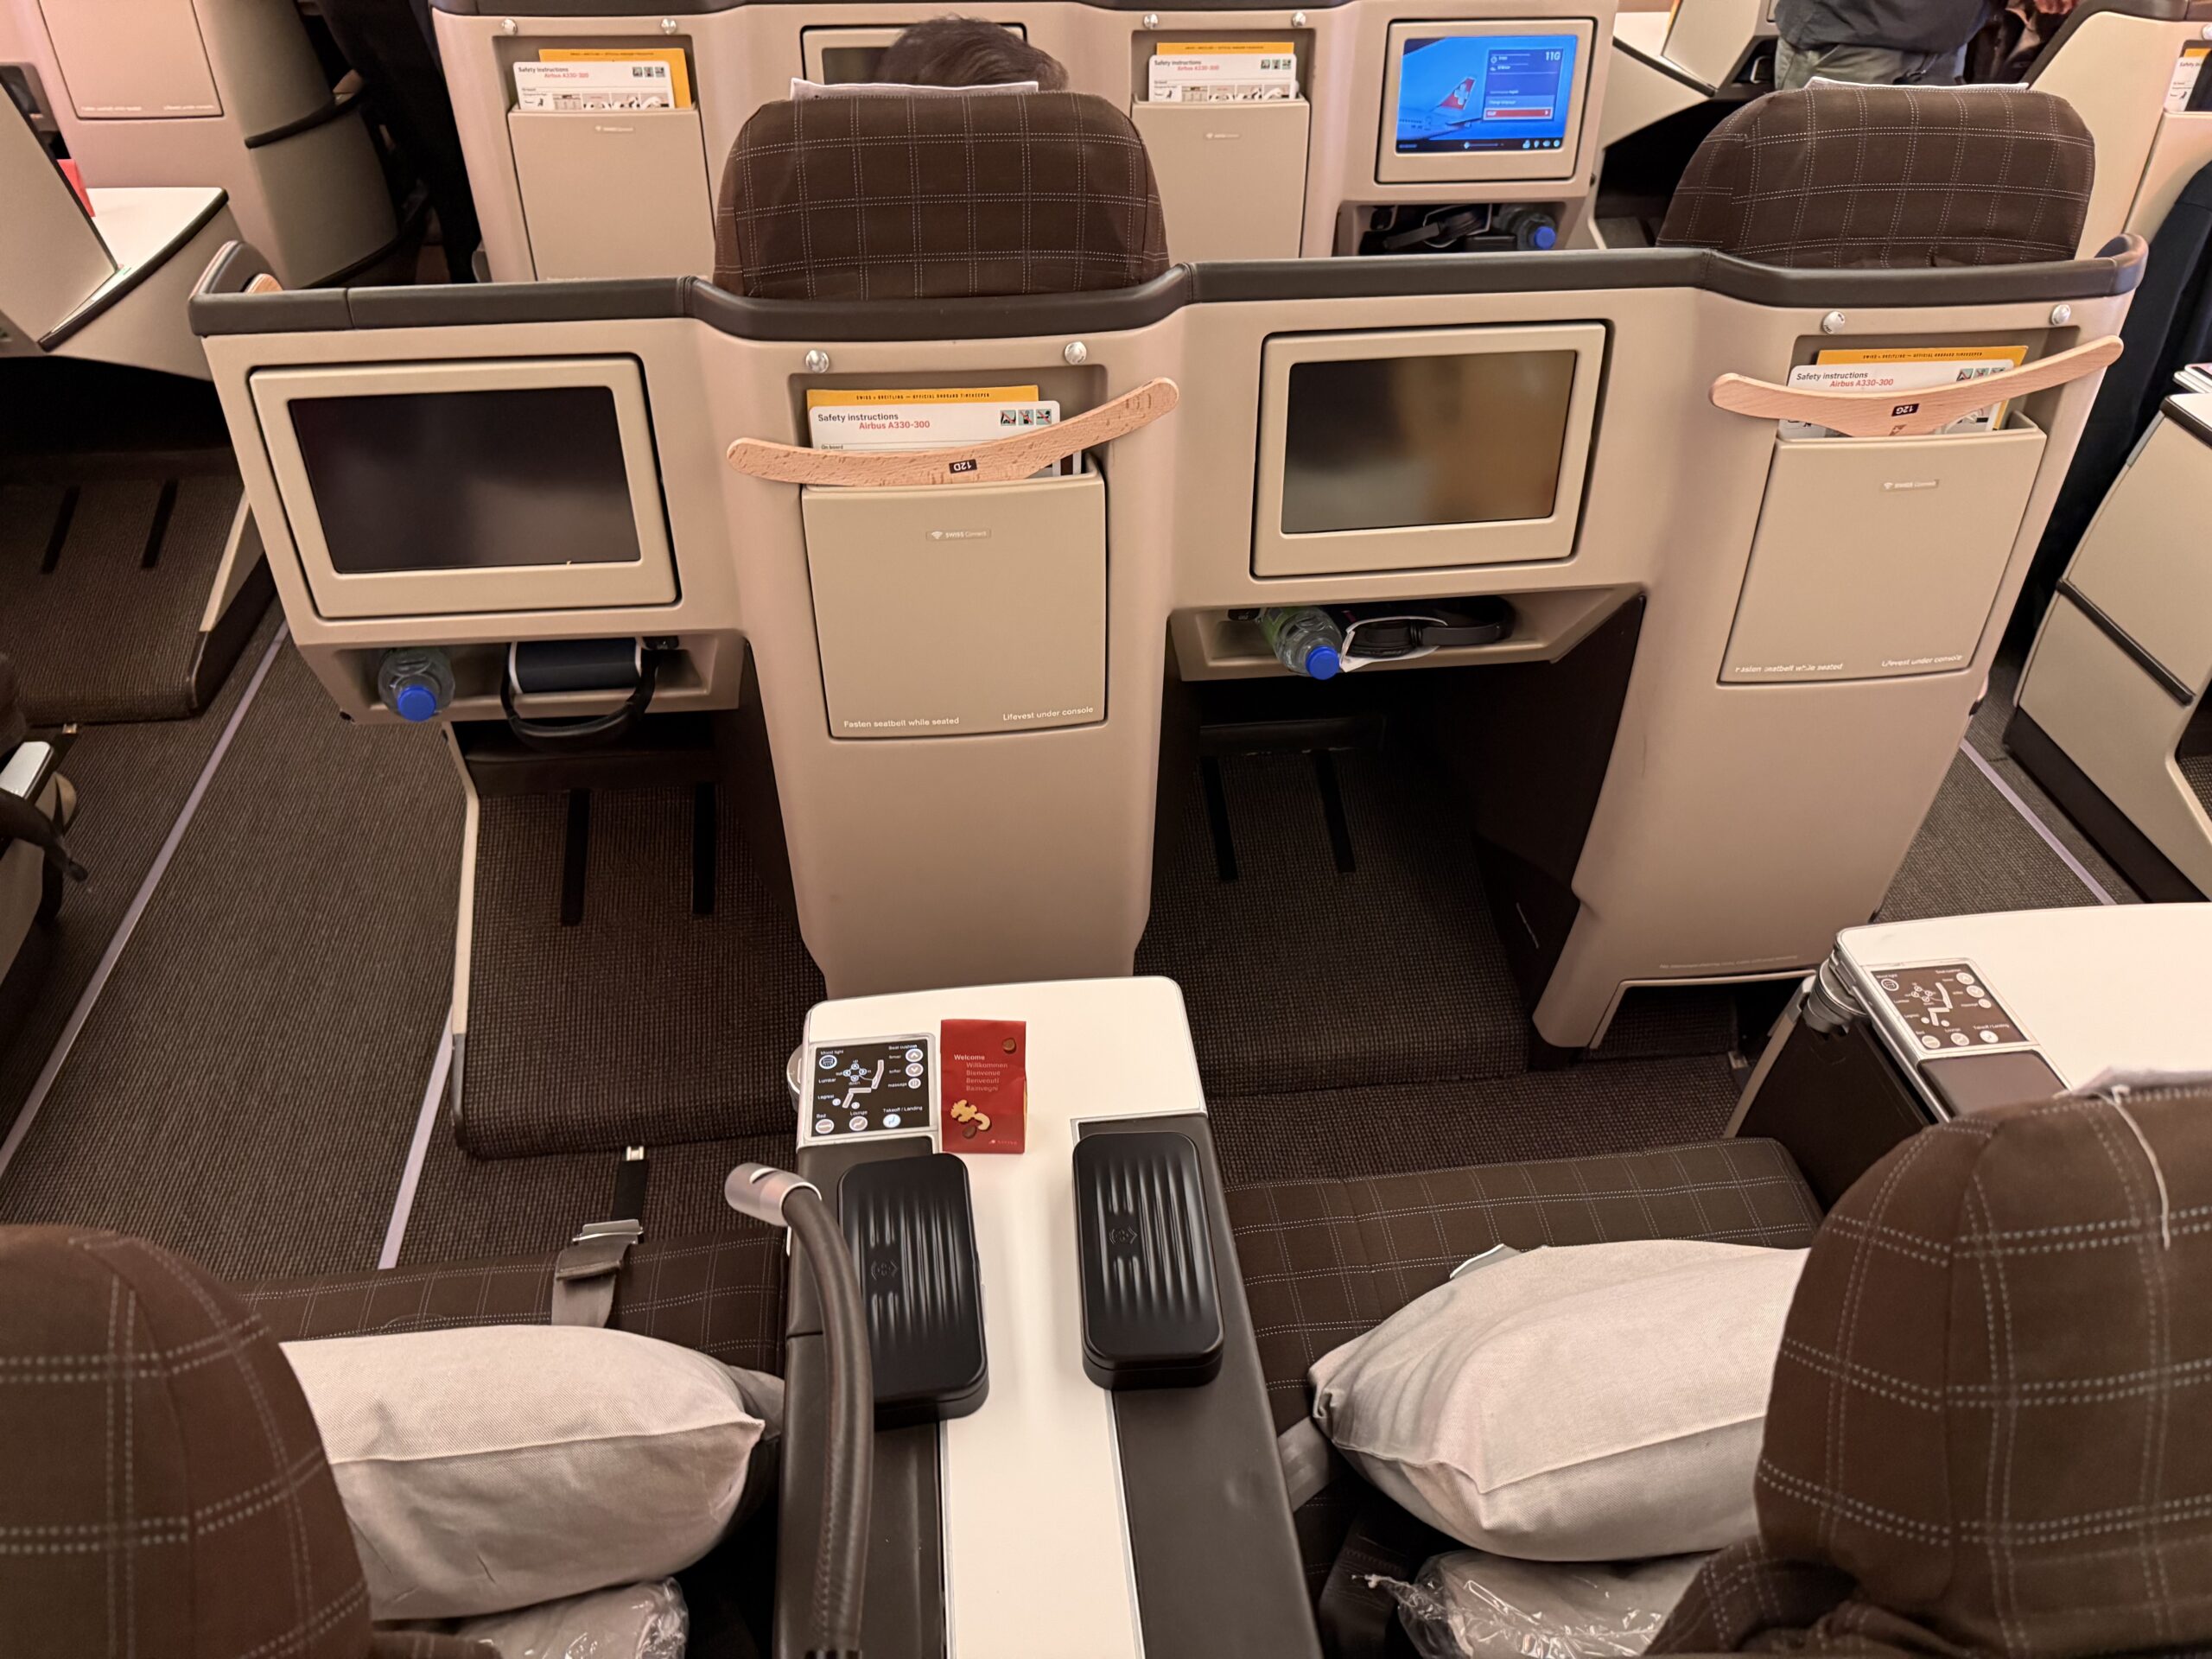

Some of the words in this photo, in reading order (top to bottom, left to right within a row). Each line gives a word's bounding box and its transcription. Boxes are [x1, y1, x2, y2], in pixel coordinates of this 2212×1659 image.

[1796, 372, 1821, 381] Safety
[1855, 378, 1894, 387] A330-300
[1896, 405, 1913, 415] 12G
[817, 414, 845, 423] Safety
[953, 461, 972, 471] 12D
[1003, 712, 1035, 721] Lifevest
[1037, 710, 1059, 719] under
[1062, 706, 1094, 716] console
[843, 720, 872, 728] Fasten
[874, 719, 906, 728] seatbelt
[908, 718, 931, 727] while
[931, 716, 960, 726] seated
